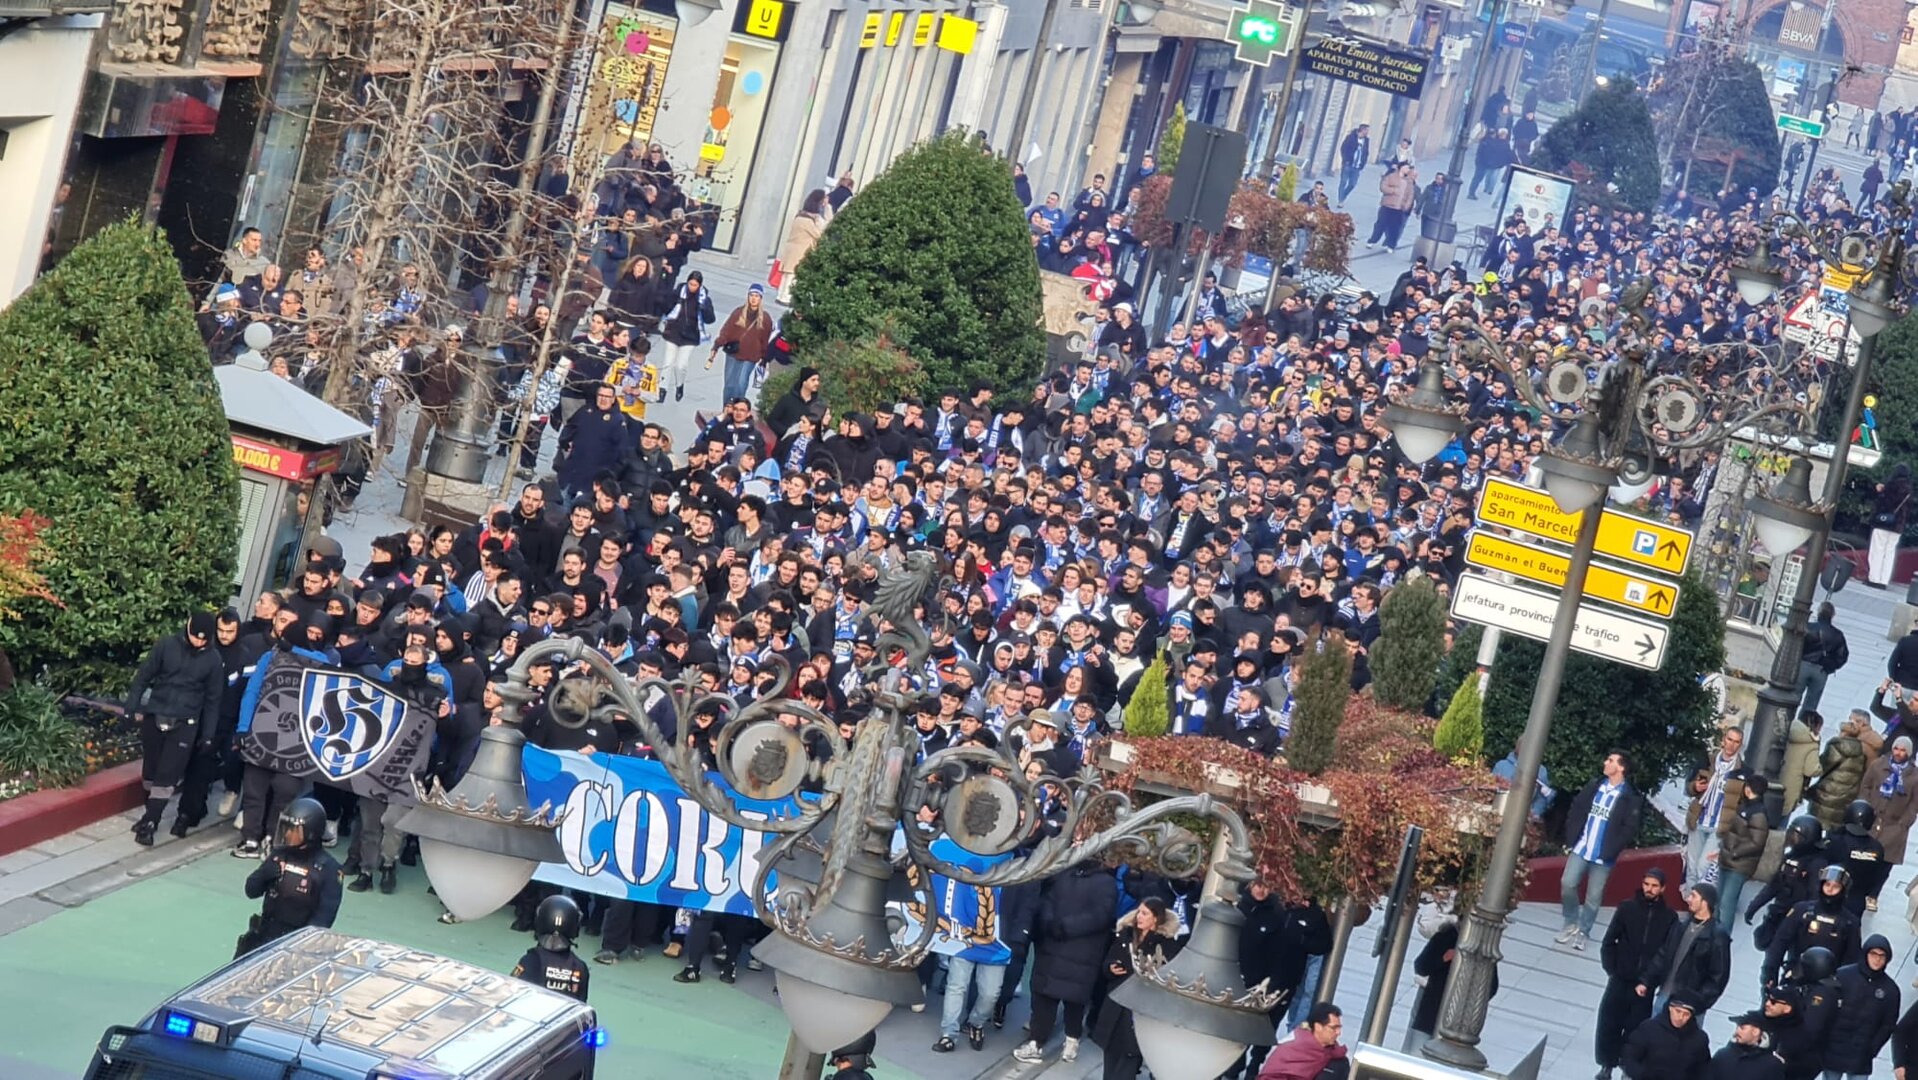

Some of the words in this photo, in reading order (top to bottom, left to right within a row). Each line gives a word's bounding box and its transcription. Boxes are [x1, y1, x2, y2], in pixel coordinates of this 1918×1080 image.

[1781, 28, 1815, 44] BBVA
[1307, 49, 1352, 67] APARATOS
[1355, 60, 1378, 74] PARA
[1381, 67, 1418, 84] SORDOS
[1312, 61, 1344, 77] LENTES
[1347, 70, 1359, 80] DE
[1362, 74, 1408, 93] CONTACTO
[1487, 502, 1516, 521] San
[1491, 489, 1562, 516] aparcamiento
[1474, 544, 1518, 565] Guzmán
[1523, 558, 1534, 568] el
[1538, 562, 1569, 578] Buen
[1463, 591, 1505, 613] jefatura
[1585, 624, 1621, 643] tráfico
[276, 674, 300, 686] Dep
